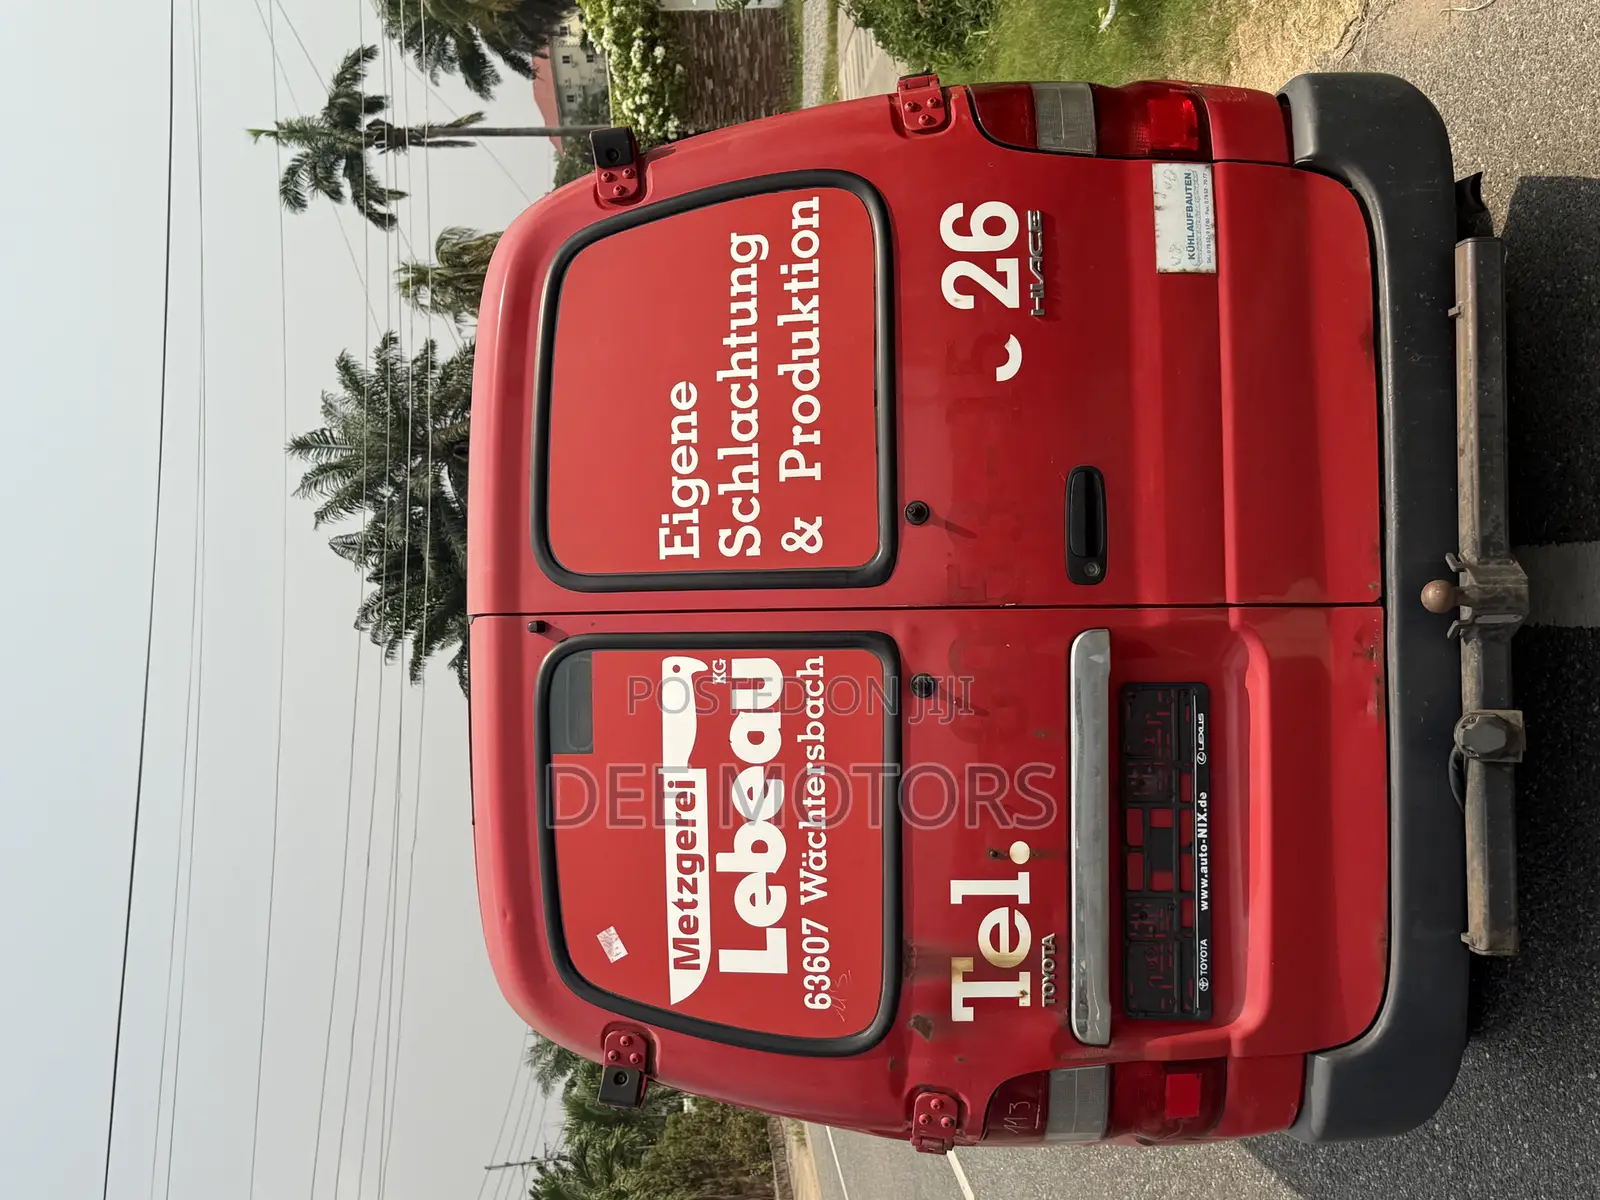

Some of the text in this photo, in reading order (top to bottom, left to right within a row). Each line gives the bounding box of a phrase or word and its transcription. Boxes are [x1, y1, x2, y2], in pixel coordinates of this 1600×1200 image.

[939, 200, 1020, 310] 26
[1027, 209, 1046, 316] HIACE
[1184, 172, 1195, 260] KÜHLAUFBAUTEN
[716, 232, 769, 557] Schlachtung
[776, 196, 824, 555] & Produktion
[658, 380, 710, 560] Eigene
[1197, 712, 1206, 751] LEXUS
[667, 779, 705, 971] Metzgerei
[712, 657, 788, 975] Lebeau KG
[796, 655, 832, 1010] 63607 Wächtersbach
[1196, 791, 1209, 911] www.auto-NIX.de
[949, 840, 1032, 1022] Tel.
[1041, 932, 1057, 1007] TOYOTA
[1199, 938, 1208, 976] TOYOTA
